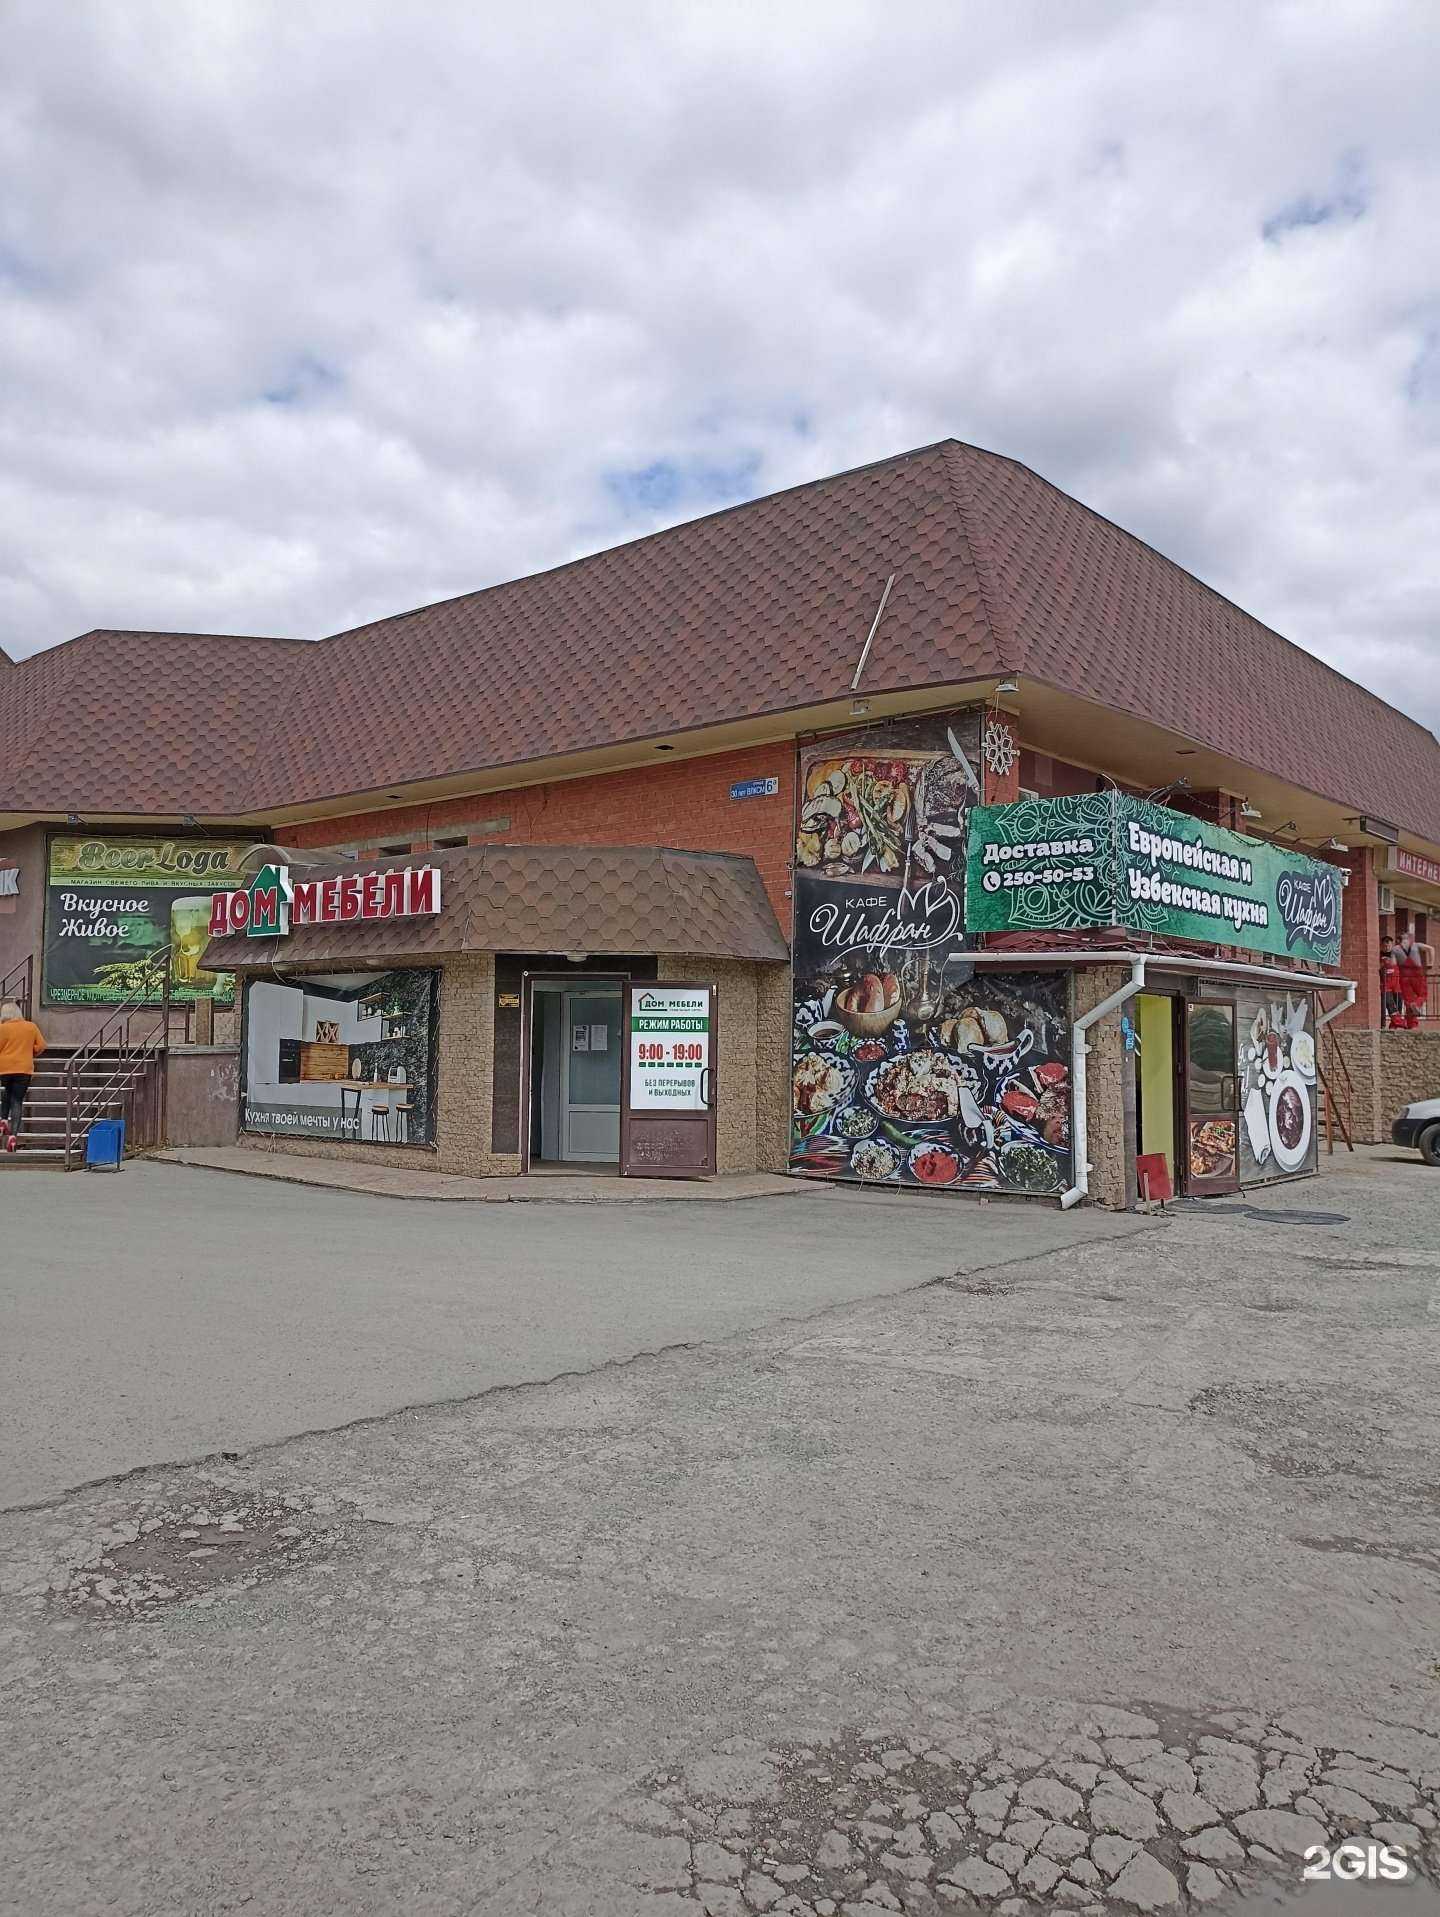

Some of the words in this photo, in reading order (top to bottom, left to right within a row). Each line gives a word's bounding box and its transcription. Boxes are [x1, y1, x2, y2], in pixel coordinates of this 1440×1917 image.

[79, 842, 156, 870] Beer
[156, 843, 230, 875] Loga
[983, 838, 1094, 865] Доставка
[1129, 822, 1240, 881] Европейская
[1240, 860, 1252, 885] и
[1003, 867, 1095, 887] 250-50-53
[59, 893, 150, 918] Вкусное
[208, 887, 278, 937] ДОМ
[292, 866, 440, 924] МЕБЕЛИ
[845, 896, 888, 909] КАФЕ
[1129, 868, 1221, 914] Узбекская
[1222, 894, 1269, 930] кухня
[59, 917, 130, 938] Живое
[809, 903, 932, 957] Шафран
[644, 1000, 665, 1008] ДОМ
[669, 1000, 703, 1008] МЕБЕЛИ
[639, 1019, 669, 1030] РЕЖИМ
[670, 1019, 703, 1030] РАБОТЫ
[638, 1043, 664, 1060] 9:00
[672, 1043, 703, 1061] 19:00
[644, 1079, 657, 1087] БЕЗ
[658, 1079, 696, 1088] ПЕРЕРЫВОВ
[654, 1088, 691, 1097] ВЫХОДНЫХ
[244, 1108, 270, 1124] Кухня
[271, 1111, 299, 1126] твоей
[300, 1114, 330, 1128] мечты
[332, 1117, 339, 1131] у
[340, 1117, 360, 1130] нас
